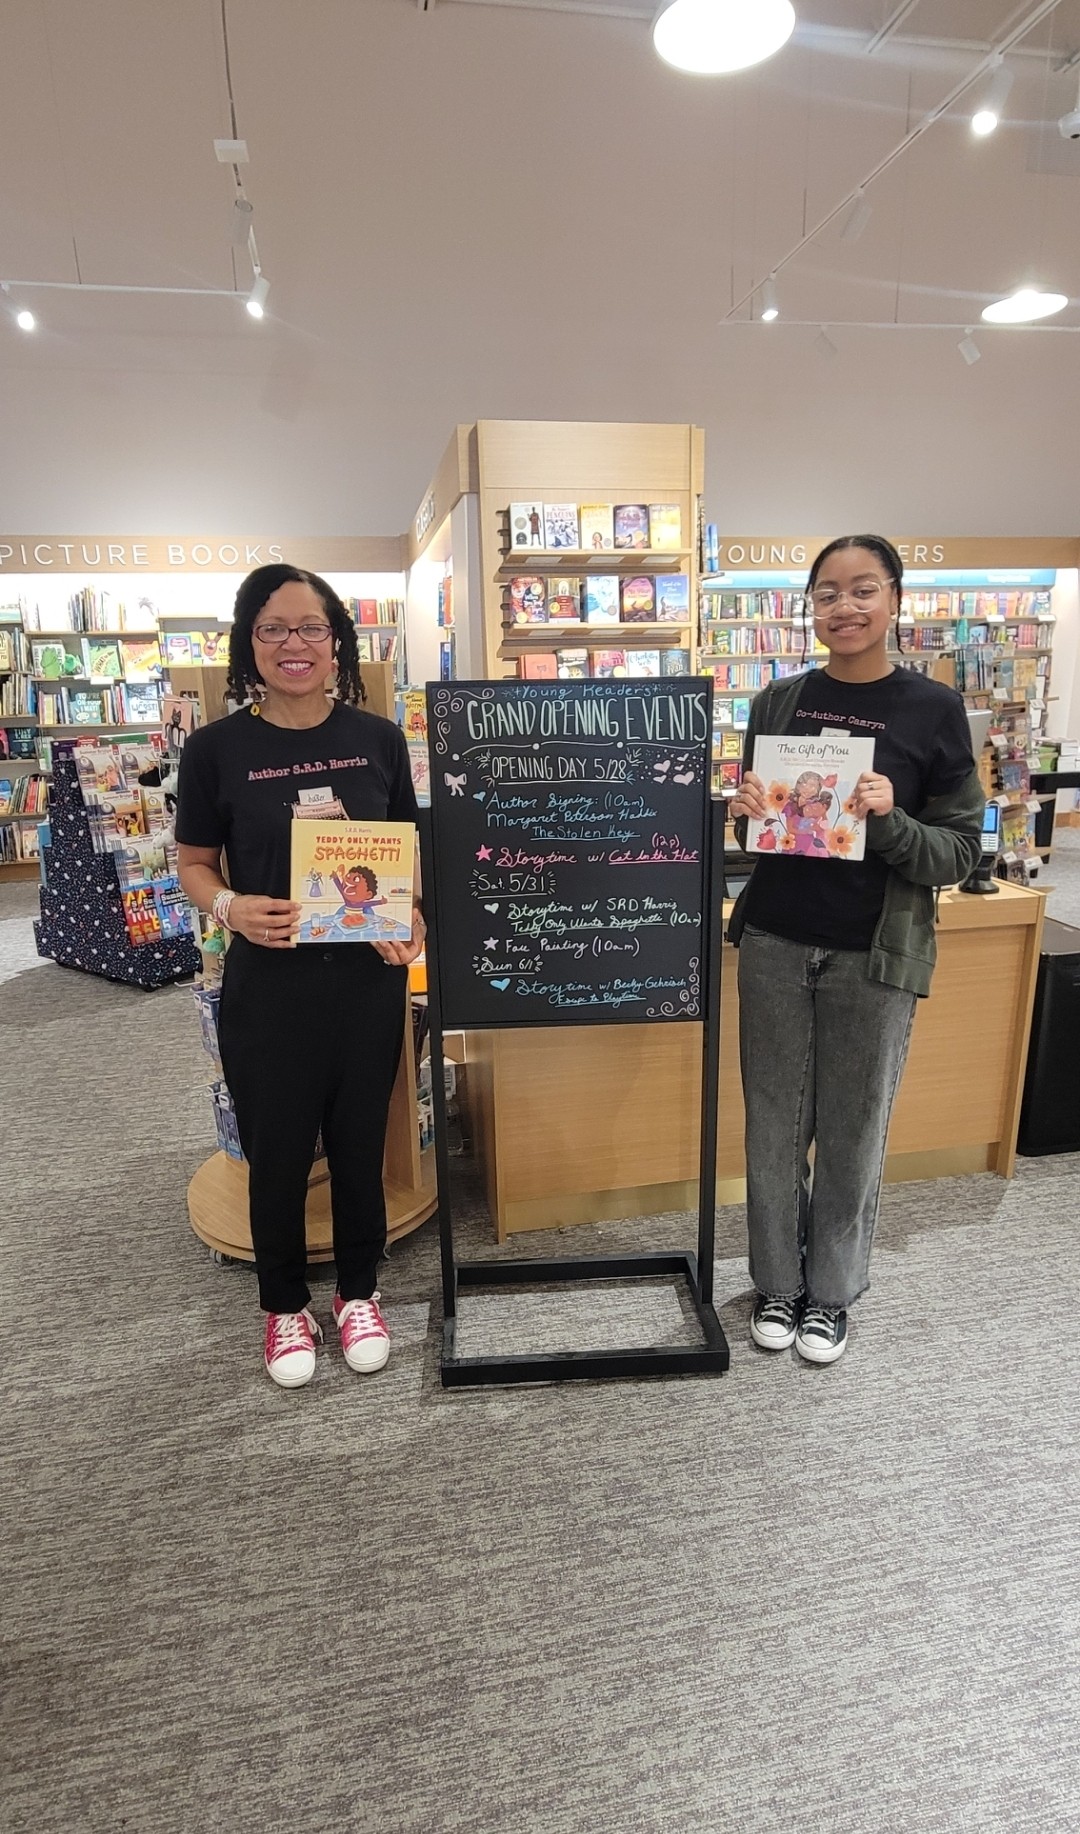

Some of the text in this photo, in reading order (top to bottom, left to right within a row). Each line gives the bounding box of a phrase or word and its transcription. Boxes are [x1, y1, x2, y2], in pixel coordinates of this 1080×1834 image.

[0, 544, 285, 566] PICTURE BOOKS
[522, 684, 651, 699] Young Readers
[467, 700, 537, 740] GRAND
[540, 698, 620, 738] OPENING
[625, 692, 708, 742] EVENTS
[795, 709, 886, 730] Co-Author Camryn
[777, 742, 850, 759] The Gift of You
[248, 756, 368, 781] Author S.R.D. Harris
[491, 756, 628, 780] OPENING DAY 5/28
[486, 791, 538, 810] Author
[604, 791, 644, 810] (10am)
[487, 812, 558, 830] Margaret
[564, 811, 614, 823] Peterson
[316, 836, 344, 844] TEDDY
[347, 836, 370, 844] ONLY
[532, 825, 636, 842] The Stolen Key
[651, 832, 680, 849] (12p)
[314, 846, 401, 862] SPAGHETTI
[496, 846, 578, 874] Storytime
[588, 852, 604, 863] w/
[608, 850, 632, 862] Cat
[651, 849, 669, 860] the
[672, 848, 699, 860] Hat
[509, 872, 544, 892] 5/31
[506, 896, 678, 926] Storytime w/ SRD Harris
[511, 911, 702, 938] Teddy Only Wants Spaghetti (10am)
[505, 935, 641, 960] Face Painting (10am)
[480, 956, 534, 972] Sun 6/1
[515, 978, 594, 1004] Storytime
[598, 982, 612, 991] w/
[613, 978, 646, 992] Becky
[557, 991, 642, 1008] Escape to Playtime
